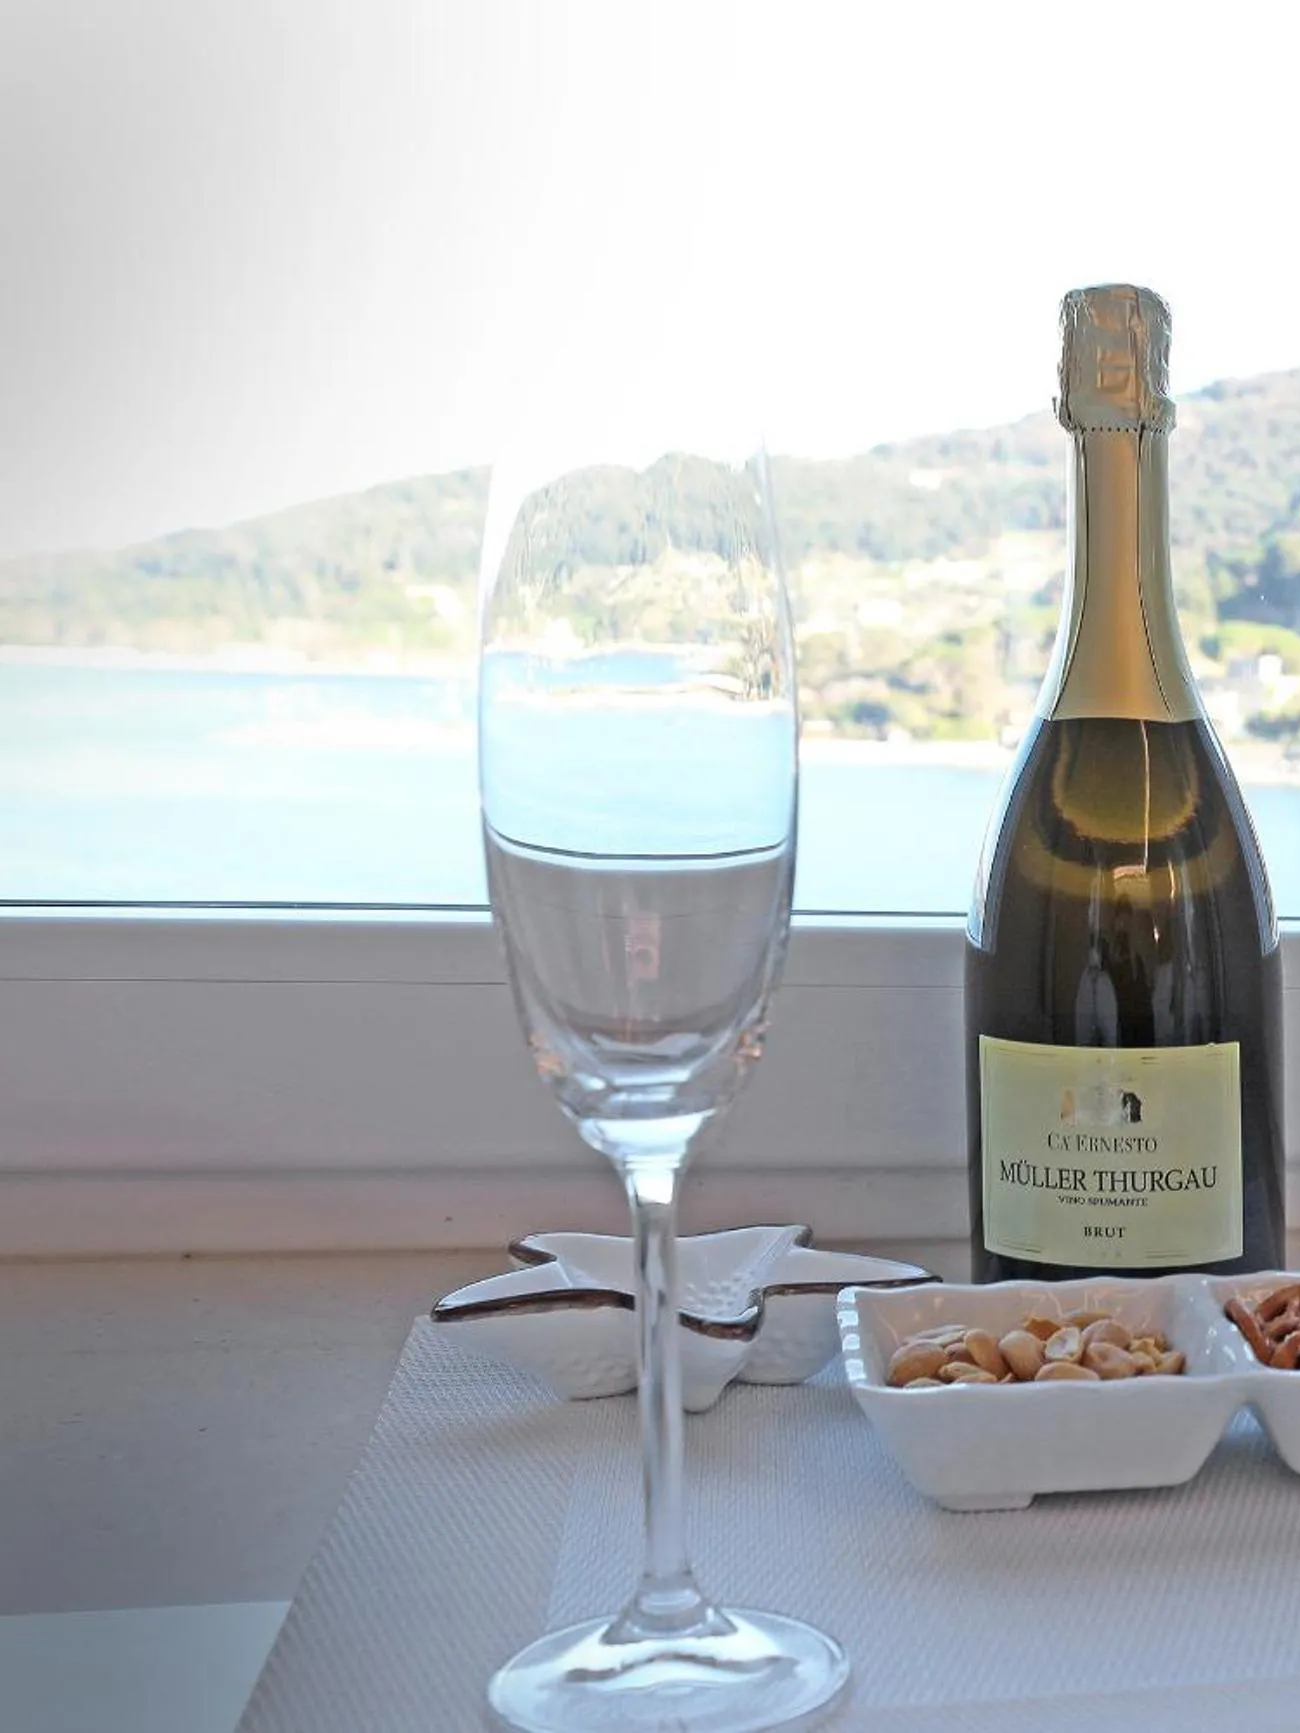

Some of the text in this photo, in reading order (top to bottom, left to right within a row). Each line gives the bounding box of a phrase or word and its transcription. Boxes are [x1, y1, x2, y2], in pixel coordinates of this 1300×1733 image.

[1076, 1134, 1158, 1153] ERNESTO
[1000, 1160, 1218, 1193] MÜLLER THURGAU
[1057, 1195, 1148, 1208] VINO SPUMANTE
[1083, 1226, 1126, 1239] BRUT
